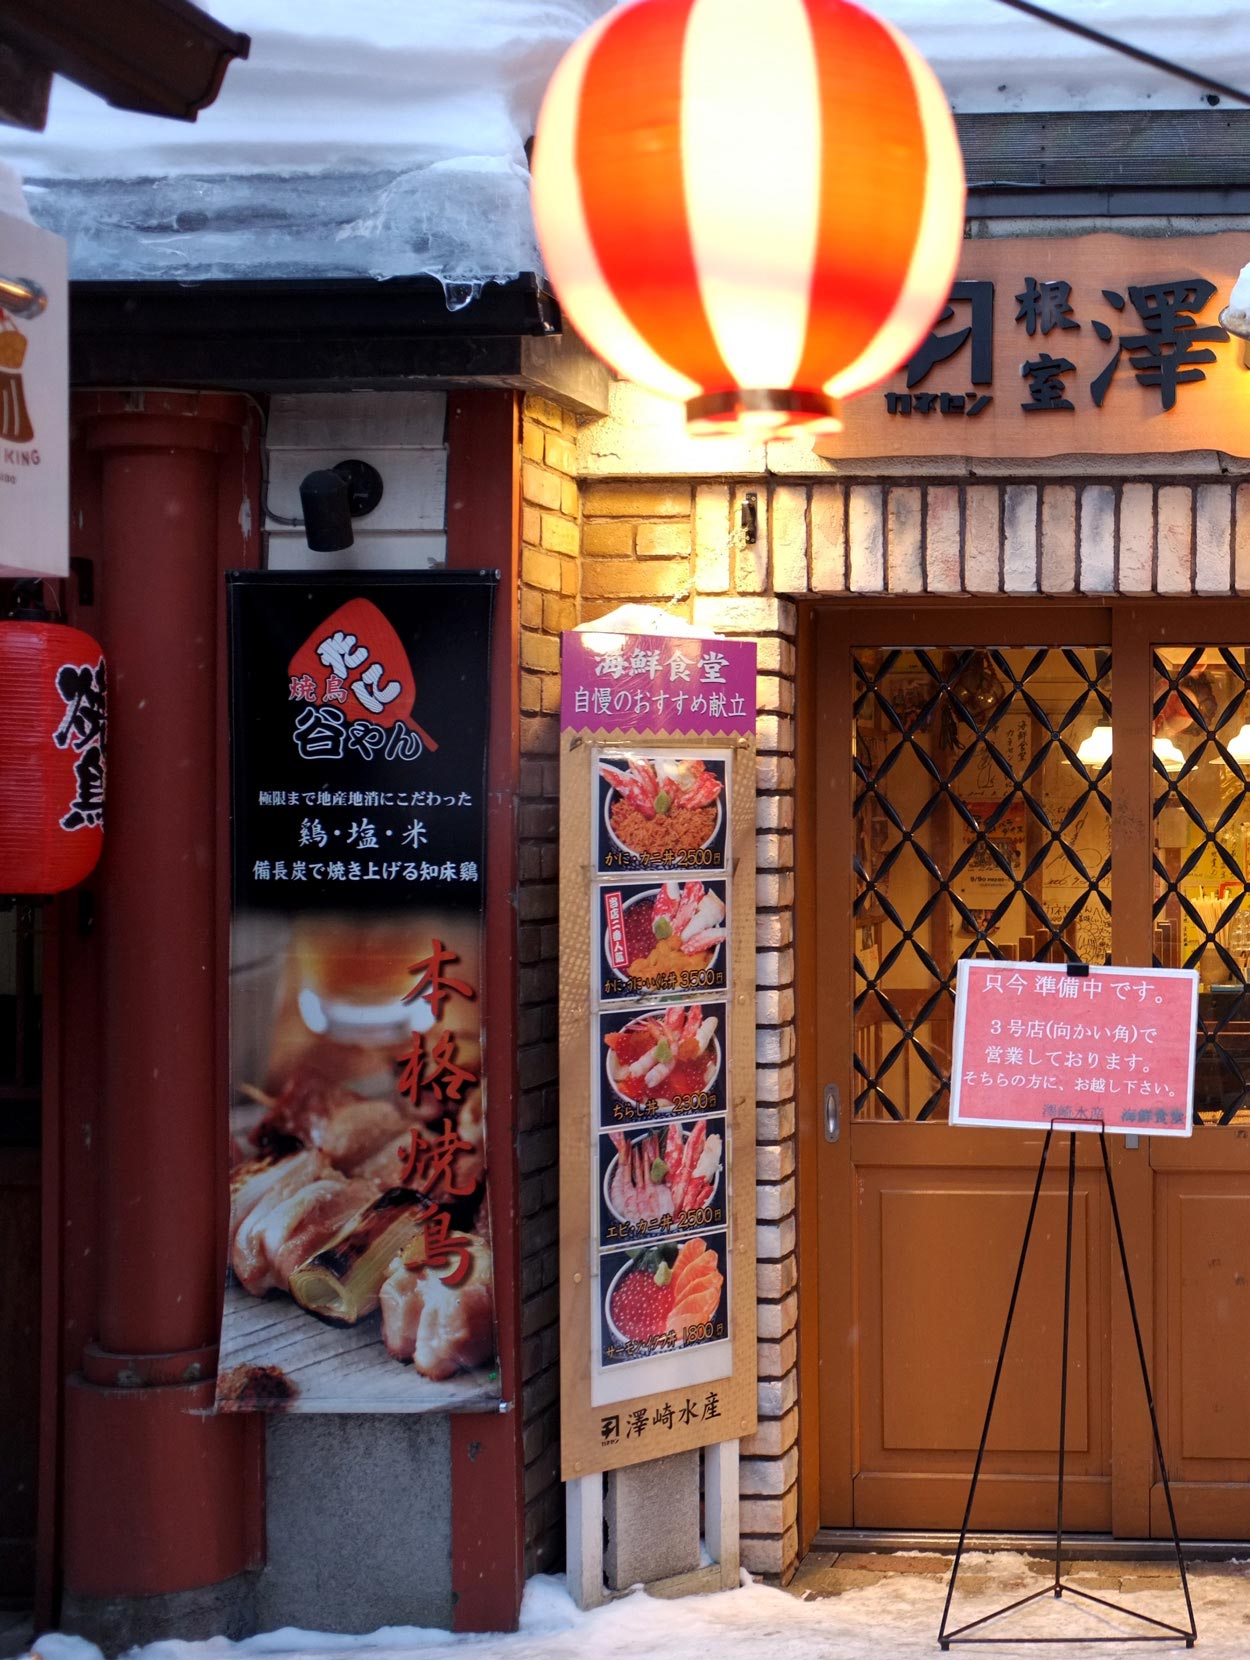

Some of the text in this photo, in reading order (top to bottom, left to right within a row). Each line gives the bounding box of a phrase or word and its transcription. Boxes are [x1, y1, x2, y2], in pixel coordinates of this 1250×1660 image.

[4, 449, 41, 466] KING
[594, 648, 730, 684] 海鮮食堂
[574, 686, 747, 718] 自慢のおすすめ献立
[293, 706, 423, 760] 谷やん
[258, 790, 473, 808] 極限まで地産地消にこだわった
[985, 1045, 1152, 1074] 営業しております。
[963, 1070, 1176, 1098] そちらの方に、お越し下さい。
[398, 938, 477, 1287] 本格焼鳥
[626, 1391, 722, 1440] 澤崎水産
